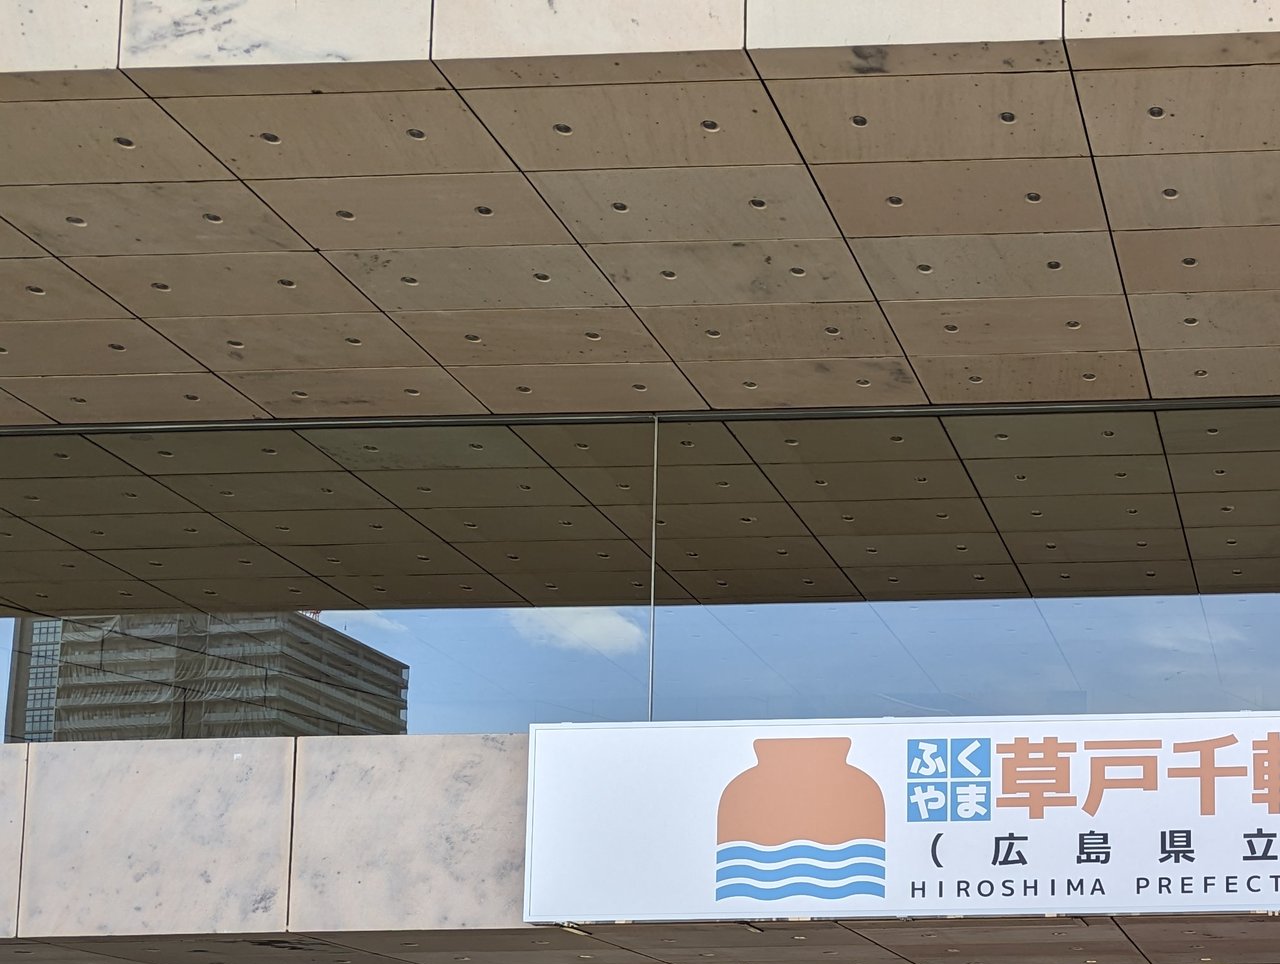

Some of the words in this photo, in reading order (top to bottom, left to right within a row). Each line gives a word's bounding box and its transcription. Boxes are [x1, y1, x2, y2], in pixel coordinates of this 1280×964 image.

[911, 740, 986, 776] ふく
[911, 785, 988, 819] やま
[911, 878, 1106, 898] HIROSHIMA
